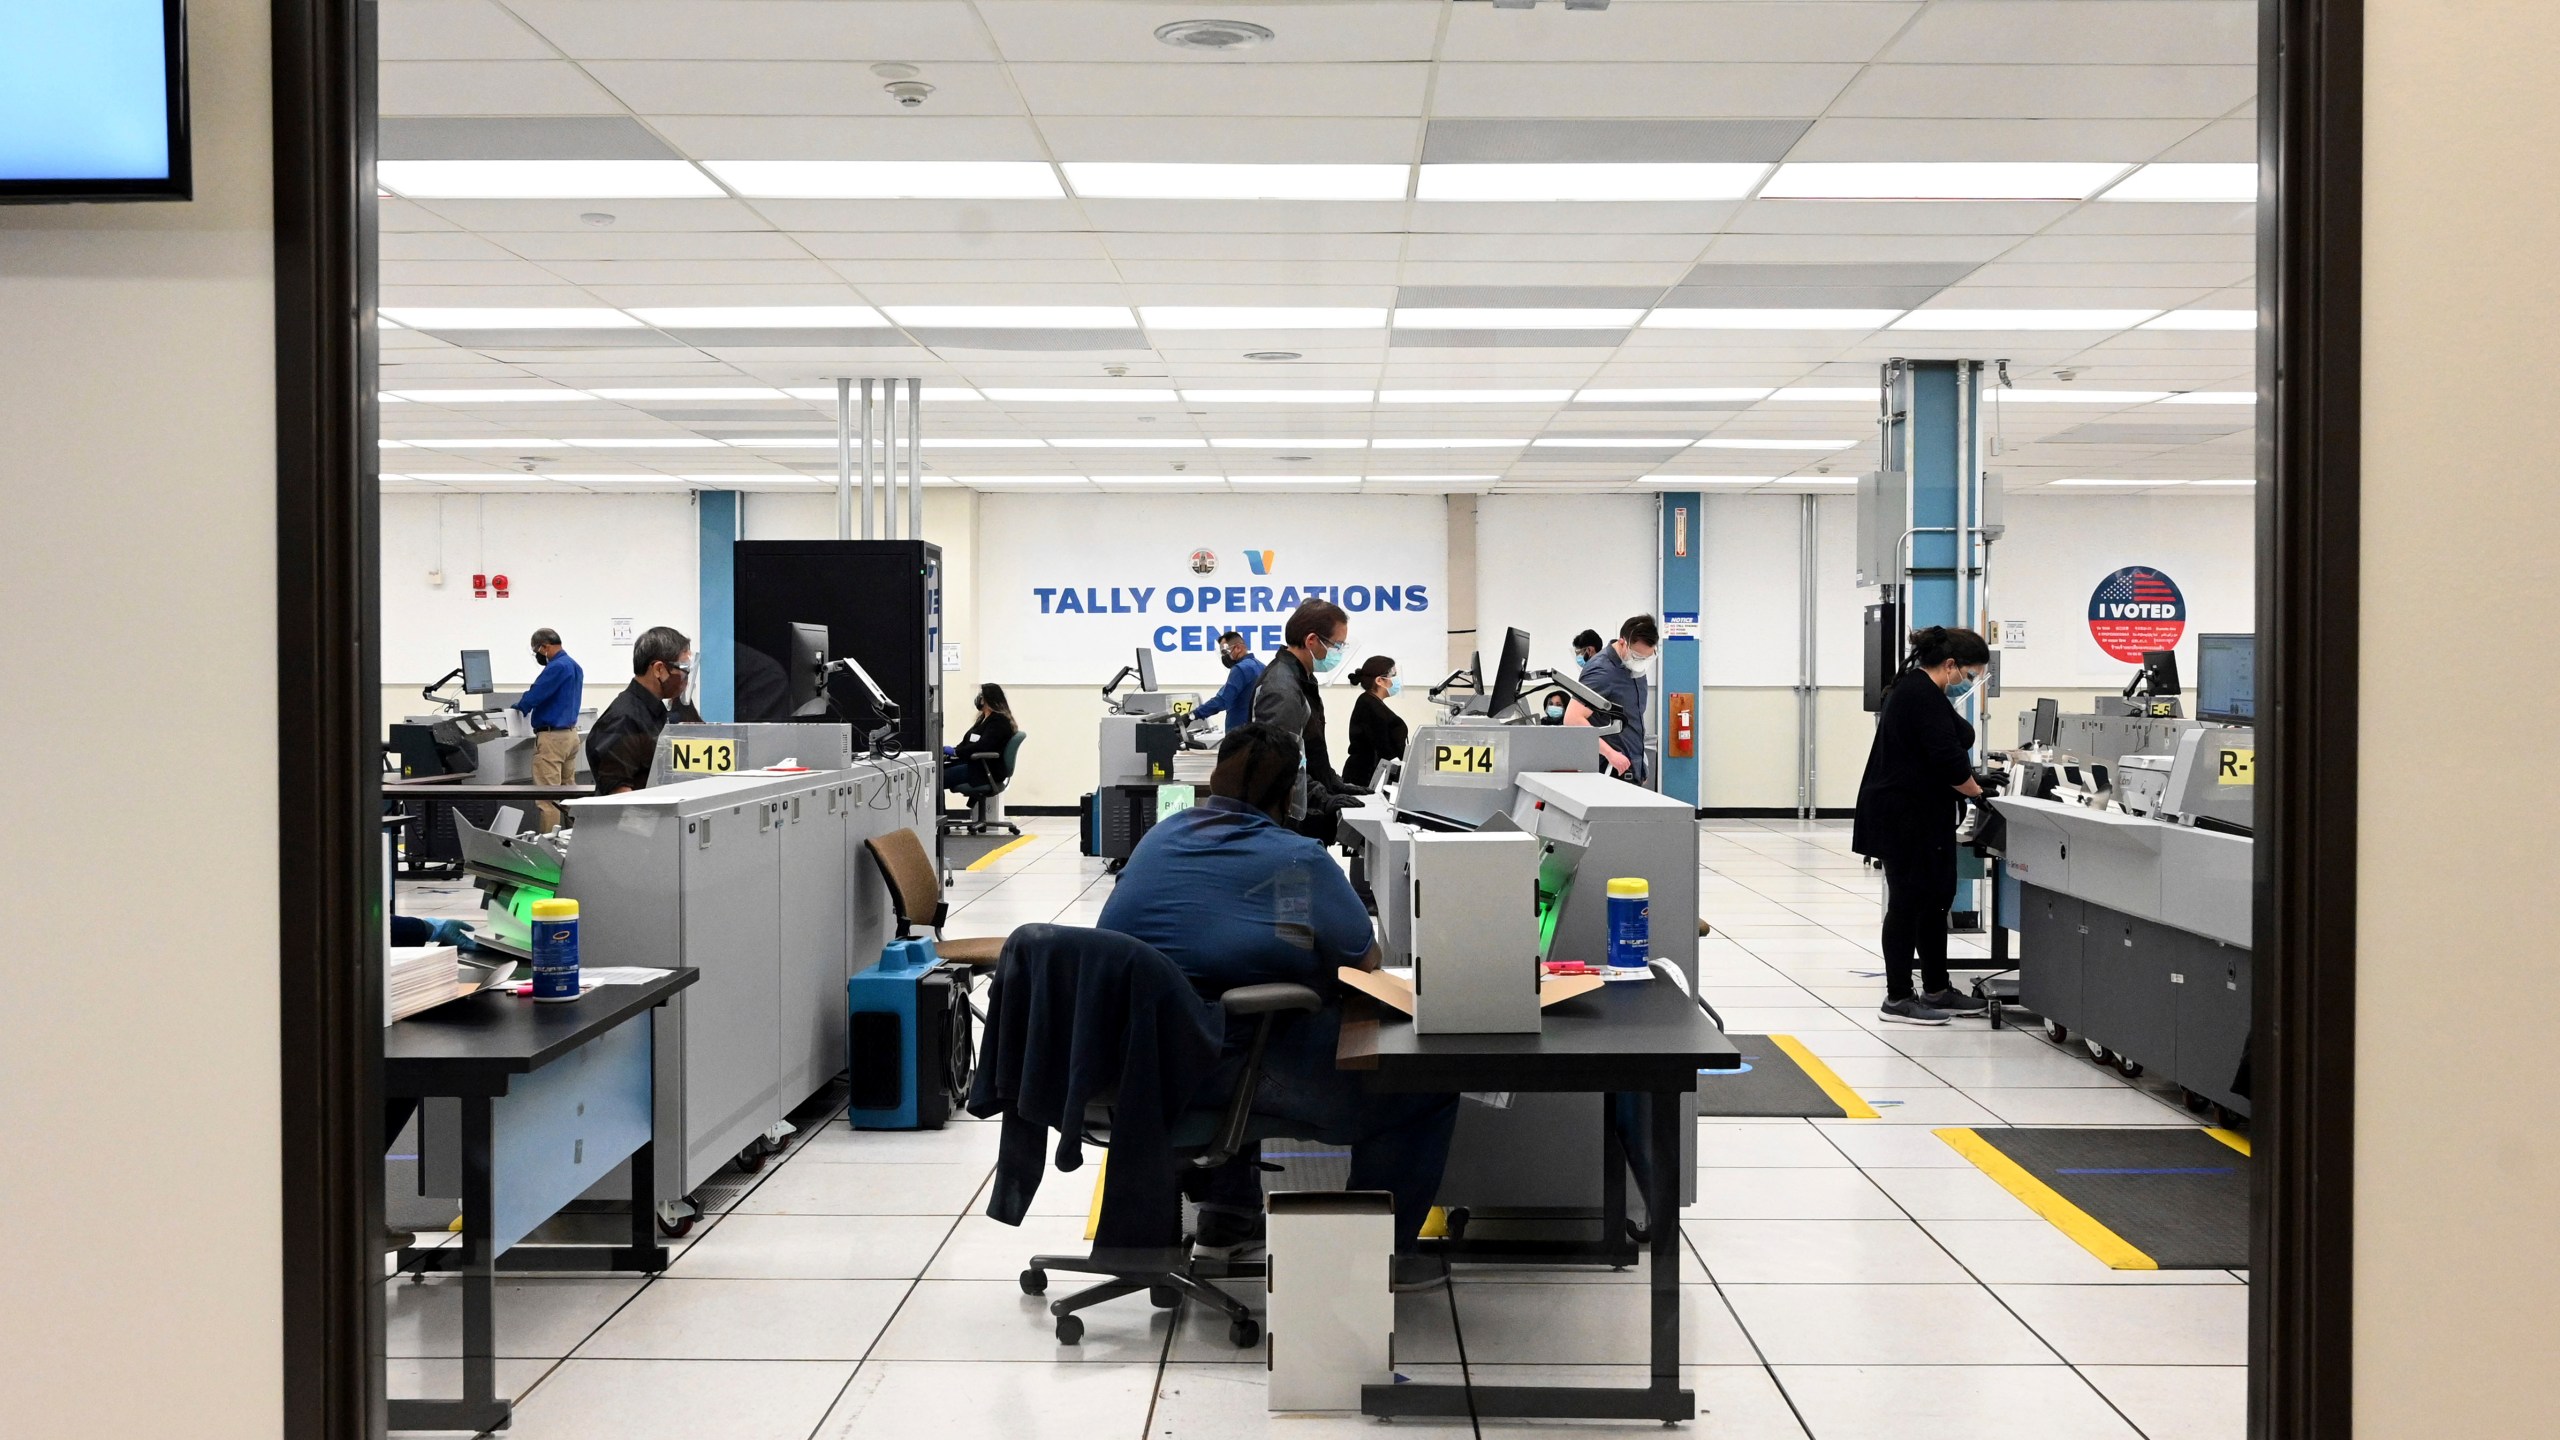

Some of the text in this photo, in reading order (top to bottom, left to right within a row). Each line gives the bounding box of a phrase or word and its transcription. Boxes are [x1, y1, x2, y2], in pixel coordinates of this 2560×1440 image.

[1033, 584, 1429, 614] TALLY OPERATIONS
[2099, 603, 2176, 619] I VOTED
[1153, 625, 1283, 652] CENTE
[1173, 702, 1193, 714] G-7
[673, 743, 732, 771] N-13
[1435, 745, 1493, 773] P-14
[2219, 750, 2255, 777] R-
